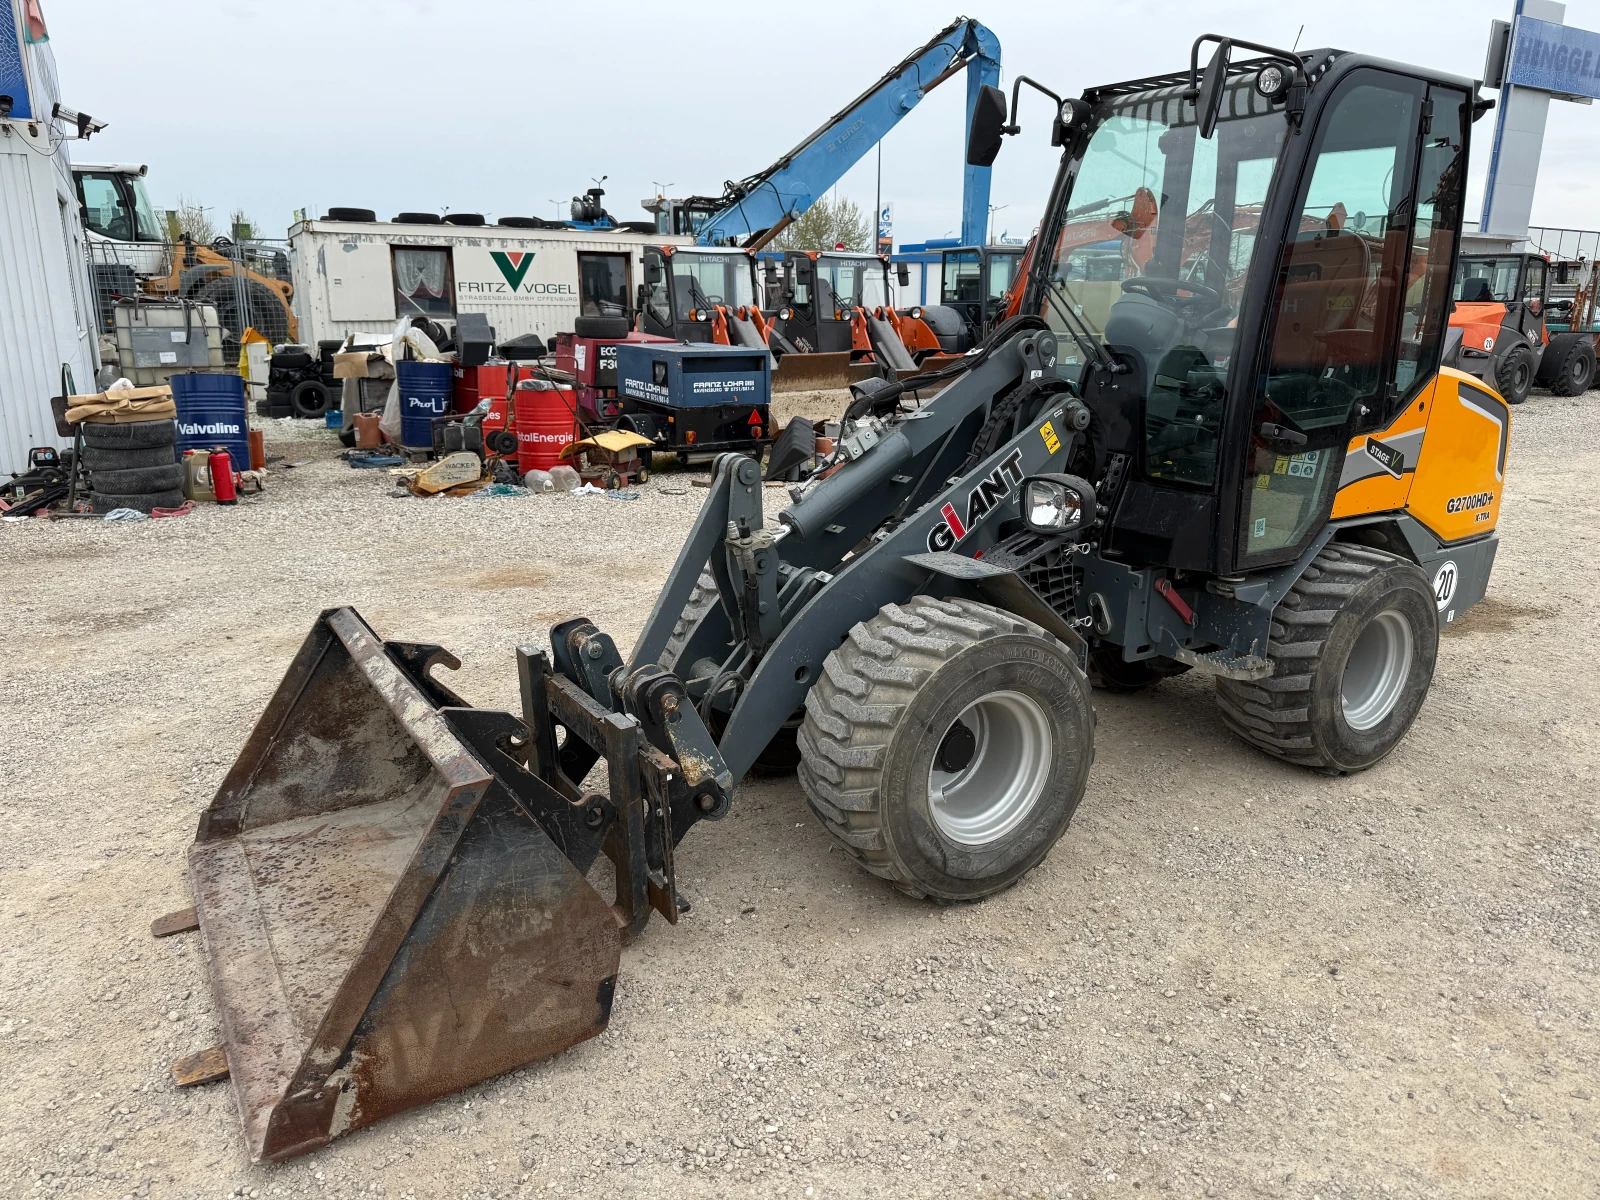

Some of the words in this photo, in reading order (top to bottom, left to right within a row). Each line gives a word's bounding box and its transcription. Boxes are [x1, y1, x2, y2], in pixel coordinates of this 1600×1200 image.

[835, 116, 866, 144] TEREX
[1065, 228, 1097, 242] HITACHI
[458, 281, 507, 293] FRITZ
[523, 283, 577, 295] VOGEL
[1485, 339, 1493, 348] 20
[453, 368, 464, 379] bil
[625, 378, 645, 391] FRANZ
[644, 382, 661, 394] LOHR
[178, 422, 241, 435] Valvoline
[1370, 444, 1391, 464] STAGE
[1390, 450, 1404, 468] V
[926, 447, 1025, 553] GIANT
[1446, 490, 1494, 514] G2700HD+
[1435, 569, 1455, 601] 20
[1041, 652, 1072, 683] POWER
